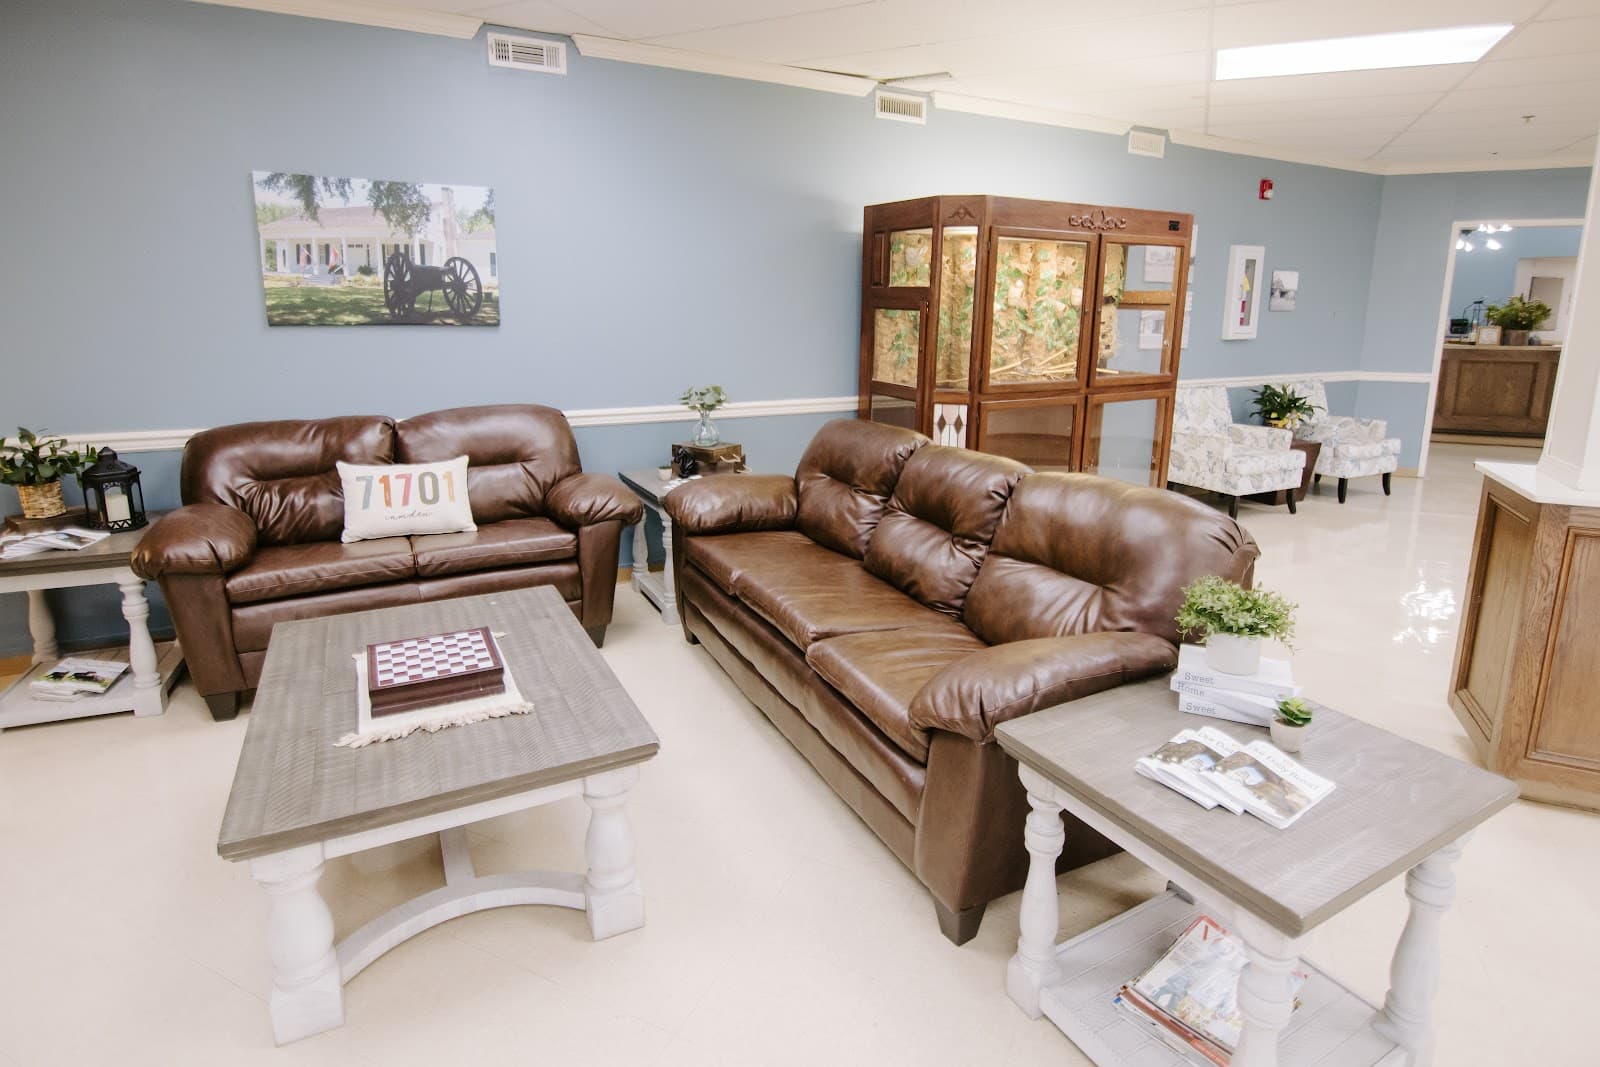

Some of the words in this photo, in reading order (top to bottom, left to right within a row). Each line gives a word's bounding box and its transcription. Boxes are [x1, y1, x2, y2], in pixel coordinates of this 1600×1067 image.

[355, 471, 456, 510] 71701
[1184, 671, 1214, 685] Sweet
[1177, 681, 1205, 697] Home
[1186, 702, 1217, 715] Sweet
